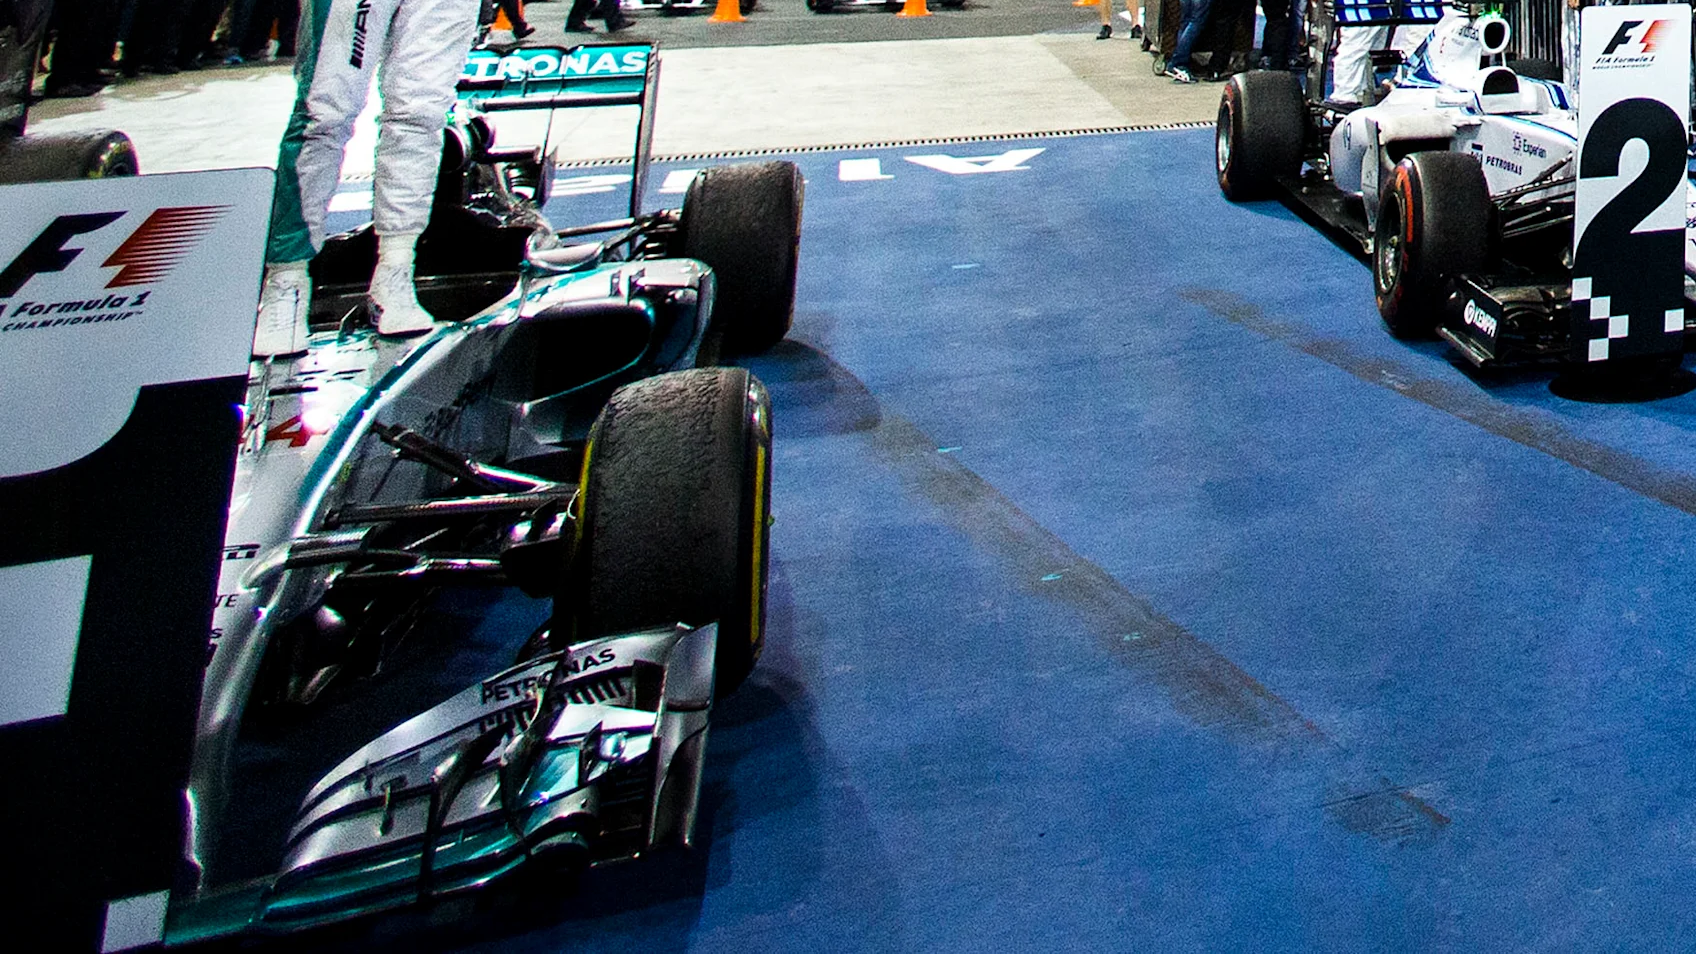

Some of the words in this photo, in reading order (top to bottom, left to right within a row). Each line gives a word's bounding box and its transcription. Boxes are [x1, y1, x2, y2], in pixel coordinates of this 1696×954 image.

[1602, 19, 1678, 55] F1
[1485, 155, 1523, 176] PETROBRAS
[1572, 97, 1688, 306] 2
[11, 292, 128, 318] Formula
[130, 291, 152, 307] 1
